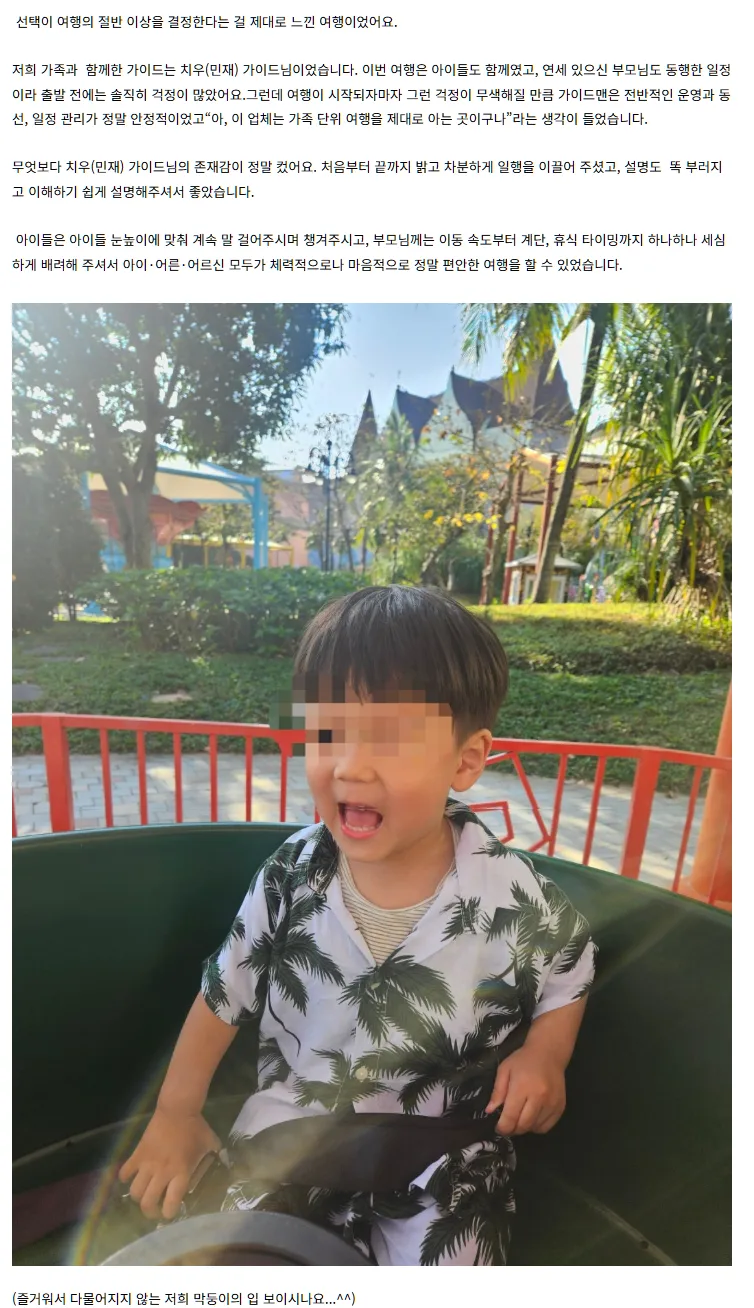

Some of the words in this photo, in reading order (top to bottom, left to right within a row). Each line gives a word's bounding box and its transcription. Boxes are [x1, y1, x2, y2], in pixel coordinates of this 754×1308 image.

[16, 15, 53, 29] 선택이
[57, 15, 94, 29] 여행의
[98, 15, 123, 29] 절반
[126, 15, 164, 29] 이상을
[167, 15, 230, 29] 결정한다는
[233, 15, 246, 29] 걸
[249, 15, 287, 29] 제대로
[290, 15, 315, 29] 느낀
[319, 15, 398, 29] 여행이었어요.
[12, 63, 36, 77] 저희
[41, 63, 79, 77] 가족과
[85, 63, 123, 77] 함께한
[126, 63, 177, 77] 가이드는
[180, 62, 239, 78] 치우(민재)
[242, 63, 358, 77] 가이드님이었습니다.
[362, 63, 386, 77] 이번
[390, 63, 428, 77] 여행은
[431, 63, 481, 77] 아이들도
[484, 63, 539, 78] 함께였고,
[542, 63, 567, 77] 연세
[571, 63, 608, 77] 있으신
[611, 63, 662, 77] 부모님도
[665, 63, 703, 77] 동행한
[706, 63, 731, 77] 일정
[11, 160, 62, 174] 무엇보다
[65, 159, 124, 175] 치우(민재)
[128, 160, 190, 174] 가이드님의
[193, 160, 243, 174] 존재감이
[247, 160, 273, 174] 정말
[276, 160, 317, 174] 컸어요.
[321, 160, 370, 174] 처음부터
[374, 160, 411, 174] 끝까지
[415, 160, 441, 174] 밝고
[444, 160, 494, 174] 차분하게
[497, 160, 535, 174] 일행을
[538, 160, 575, 174] 이끌어
[579, 160, 621, 175] 주셨고,
[624, 160, 662, 174] 설명도
[669, 160, 682, 174] 똑
[685, 160, 722, 174] 부러지
[11, 258, 37, 272] 하게
[41, 258, 78, 272] 배려해
[81, 258, 118, 272] 주셔서
[122, 258, 225, 272] 아이·어른·어르신
[229, 258, 267, 272] 모두가
[269, 258, 345, 272] 체력적으로나
[348, 258, 410, 272] 마음적으로
[414, 258, 439, 272] 정말
[442, 258, 480, 272] 편안한
[483, 258, 521, 272] 여행을
[524, 258, 537, 272] 할
[540, 258, 553, 272] 수
[557, 258, 623, 272] 있었습니다.
[12, 1291, 66, 1307] (즐거워서
[70, 1292, 132, 1306] 다물어지지
[136, 1292, 161, 1306] 않는
[164, 1292, 189, 1306] 저희
[193, 1292, 242, 1306] 막둥이의
[247, 1292, 259, 1306] 입
